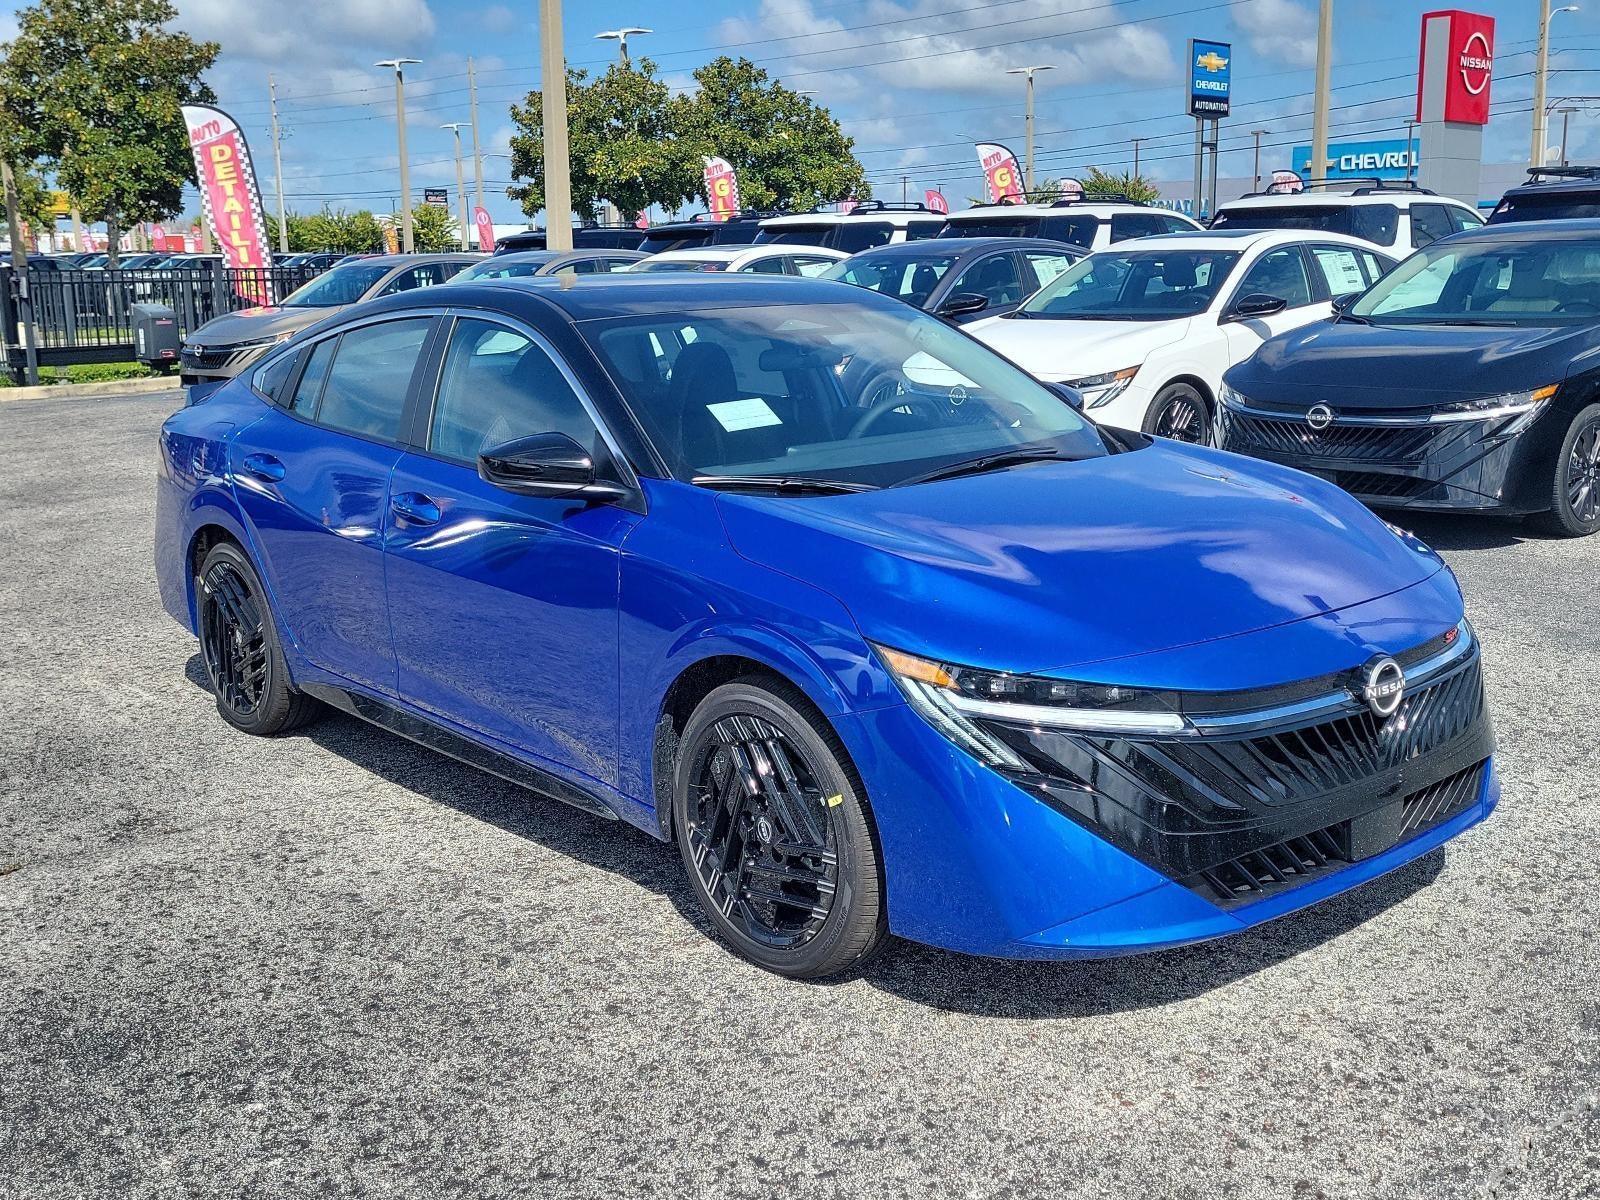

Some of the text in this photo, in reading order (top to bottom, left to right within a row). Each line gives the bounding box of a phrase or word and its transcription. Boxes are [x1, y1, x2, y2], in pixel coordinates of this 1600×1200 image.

[1460, 55, 1492, 71] NISSAN
[1195, 79, 1228, 92] CHEVROLET
[1194, 100, 1228, 112] AUTONATION
[191, 119, 221, 142] AUTO
[982, 151, 1002, 169] AUTO
[1305, 414, 1333, 422] NISSAN
[1367, 677, 1406, 698] NISSAN
